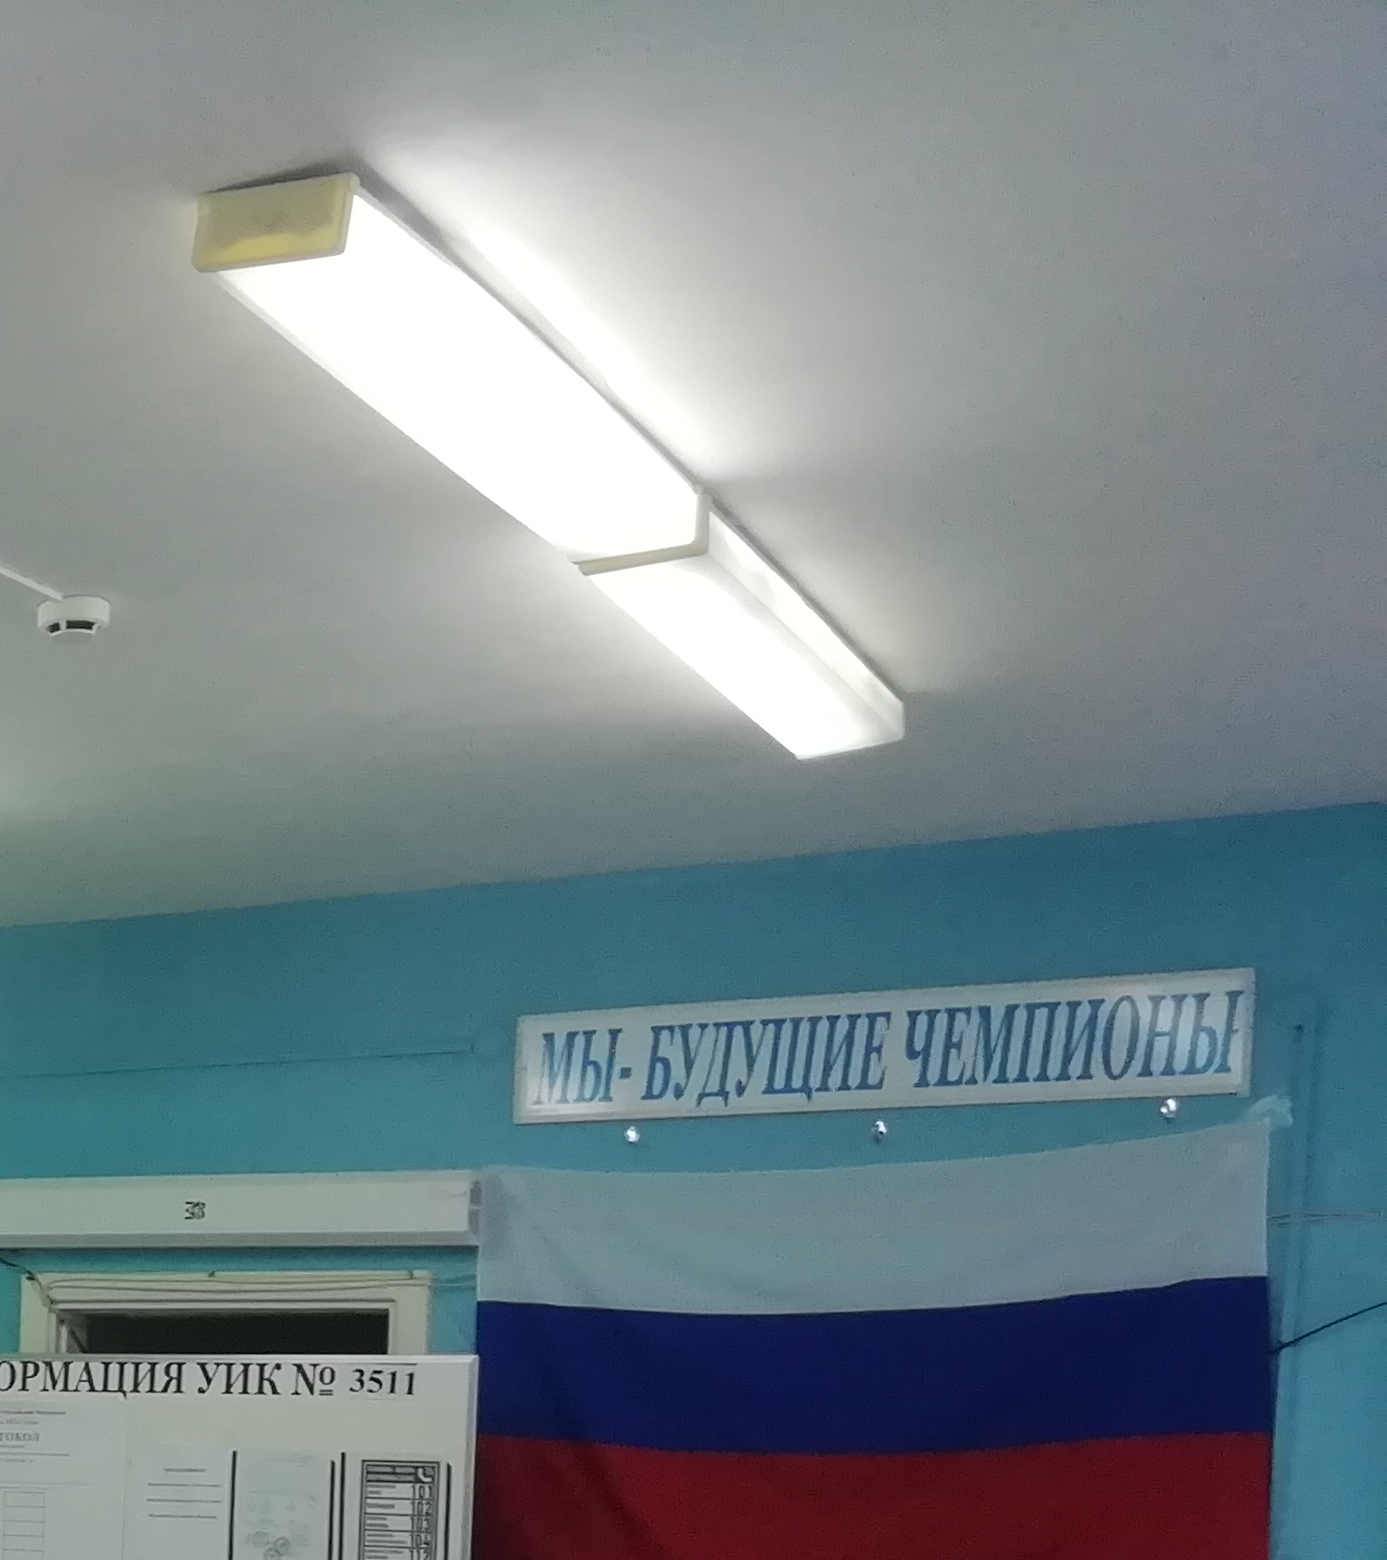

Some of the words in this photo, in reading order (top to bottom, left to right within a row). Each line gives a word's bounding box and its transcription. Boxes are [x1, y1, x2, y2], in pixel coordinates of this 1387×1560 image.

[640, 1011, 890, 1110] БУДУЩИЕ
[905, 989, 1244, 1087] ЧЕМПИОНЫ
[195, 1361, 282, 1396] УИК
[290, 1362, 337, 1397] №
[348, 1367, 415, 1396] 3511
